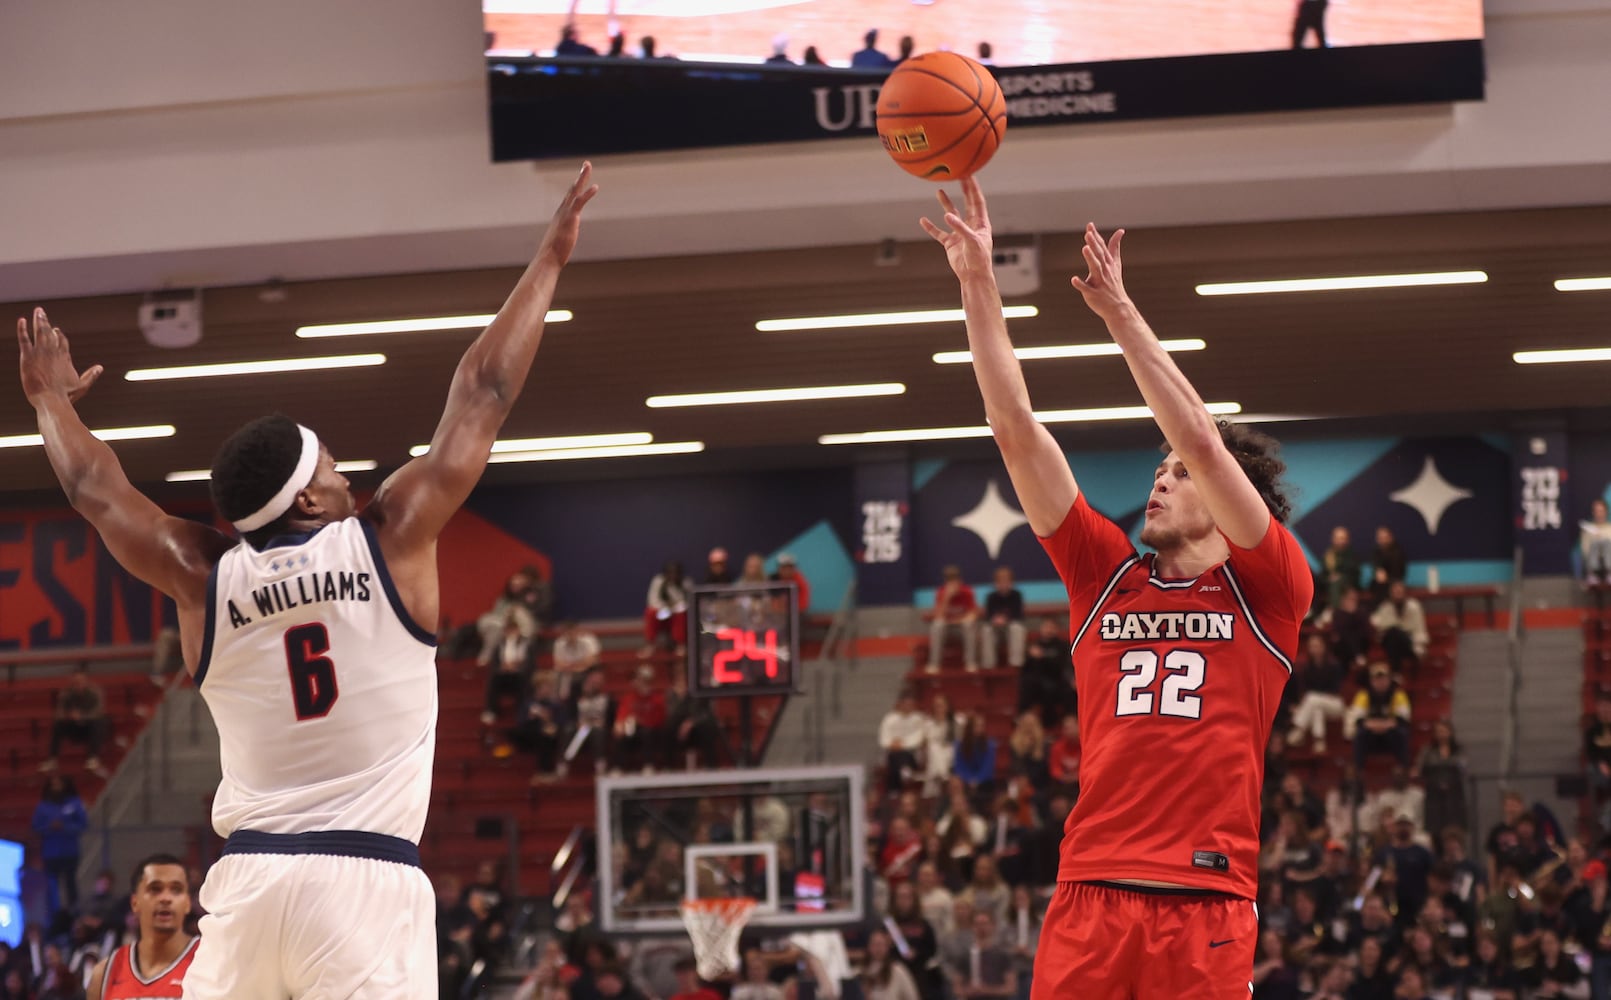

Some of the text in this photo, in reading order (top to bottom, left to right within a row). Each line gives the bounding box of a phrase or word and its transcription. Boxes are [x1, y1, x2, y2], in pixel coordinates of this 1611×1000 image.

[813, 84, 878, 130] UP
[1000, 71, 1094, 95] SPORTS
[228, 571, 370, 629] A. WILLIAMS
[1100, 612, 1234, 640] DAYTON
[283, 621, 339, 722] 6
[713, 627, 778, 683] 24
[1116, 650, 1206, 719] 22
